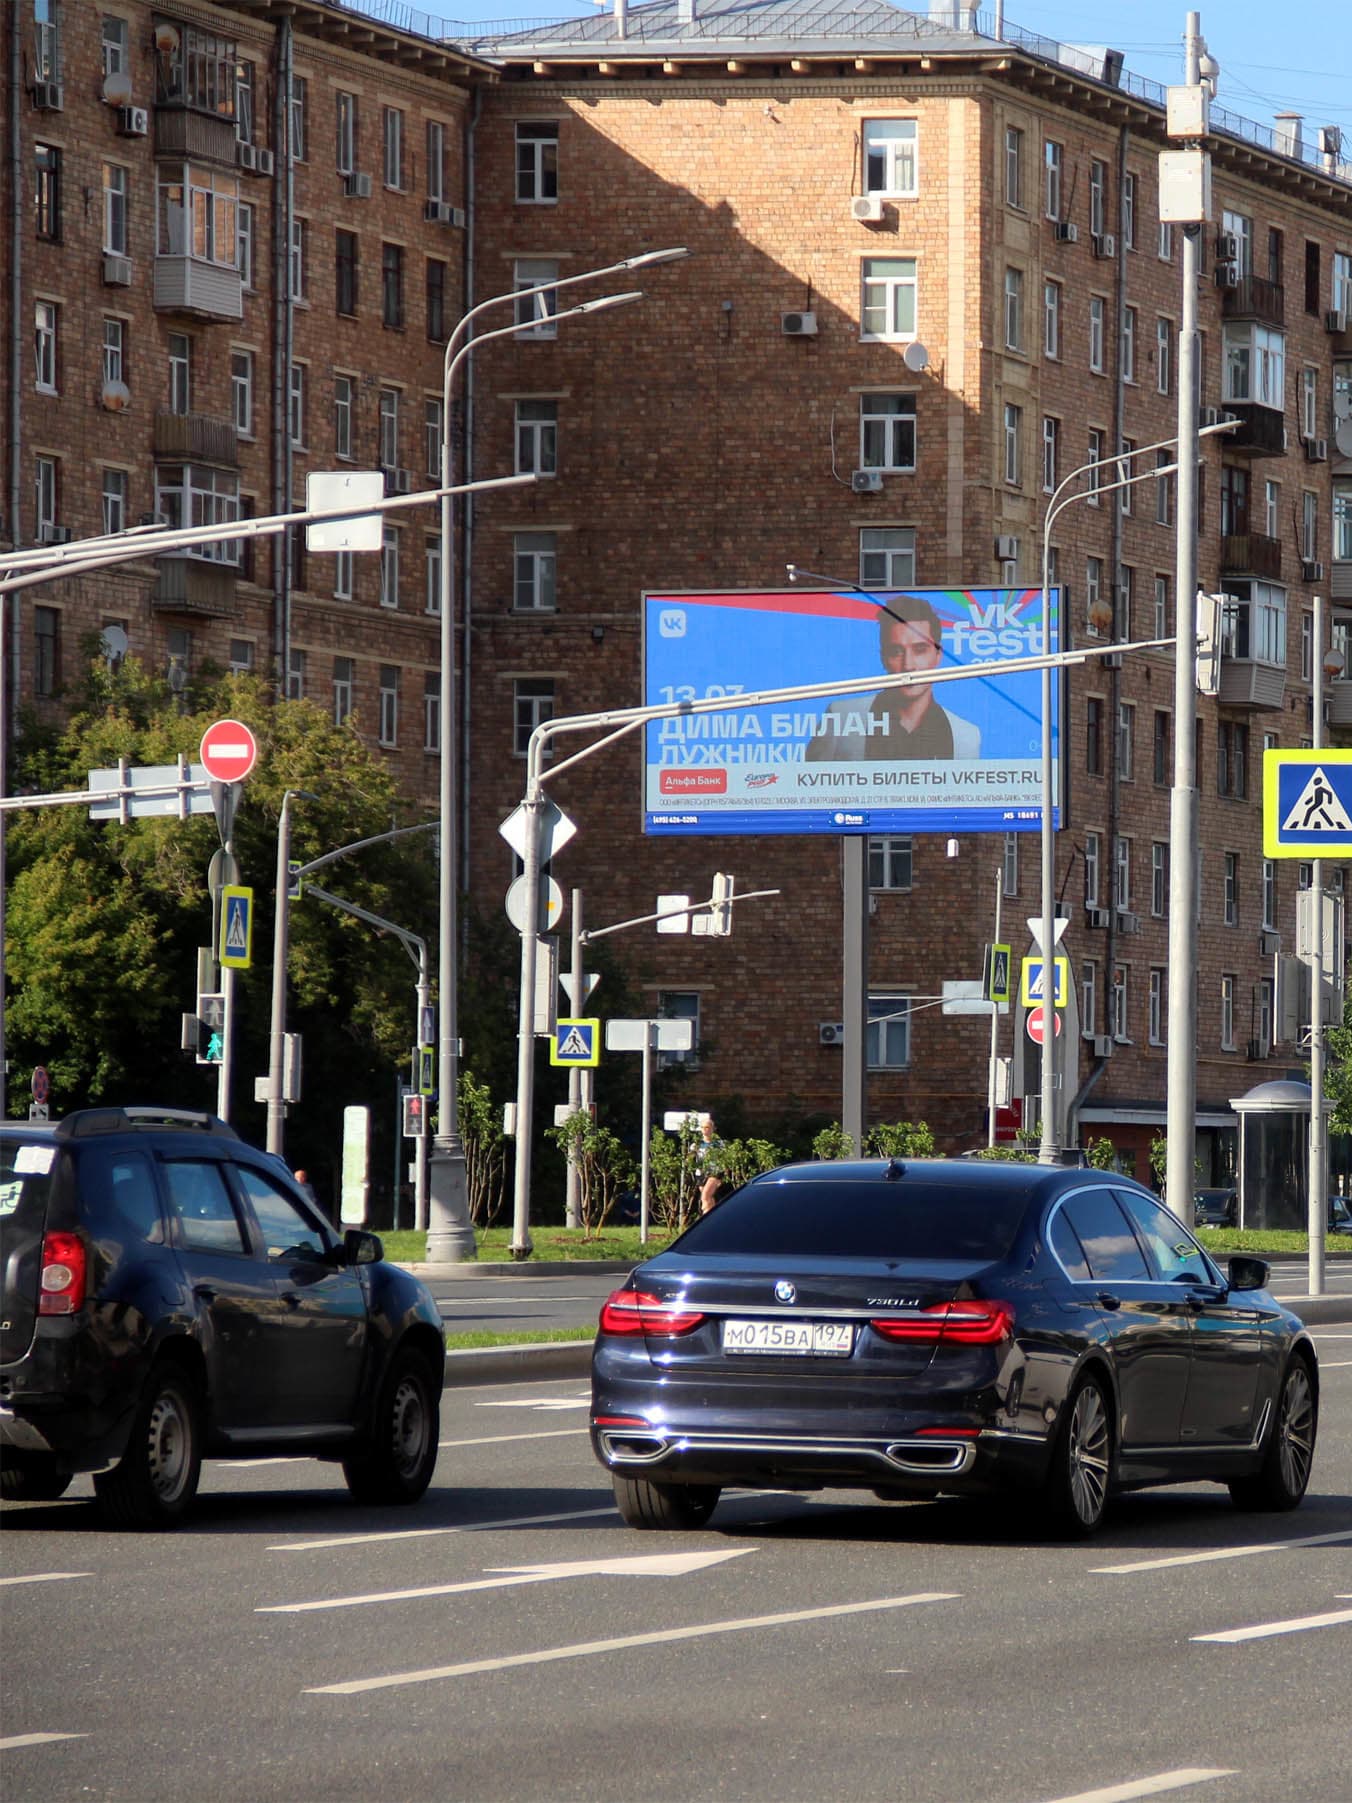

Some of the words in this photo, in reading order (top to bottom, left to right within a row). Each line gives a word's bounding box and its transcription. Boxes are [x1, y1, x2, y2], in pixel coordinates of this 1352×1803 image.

[968, 603, 1024, 628] VK
[942, 621, 1057, 656] fest
[659, 685, 744, 704] 130
[658, 713, 764, 744] ДИМА
[771, 711, 889, 738] БИЛАН
[659, 743, 806, 764] ЛУЖНИКИ
[665, 776, 696, 788] Альфа
[698, 776, 721, 785] Банк
[797, 772, 868, 786] КУПИТЬ
[873, 771, 947, 786] БИЛЕТЫ
[952, 770, 1042, 785] VKFEST.RU
[815, 1325, 846, 1341] 197
